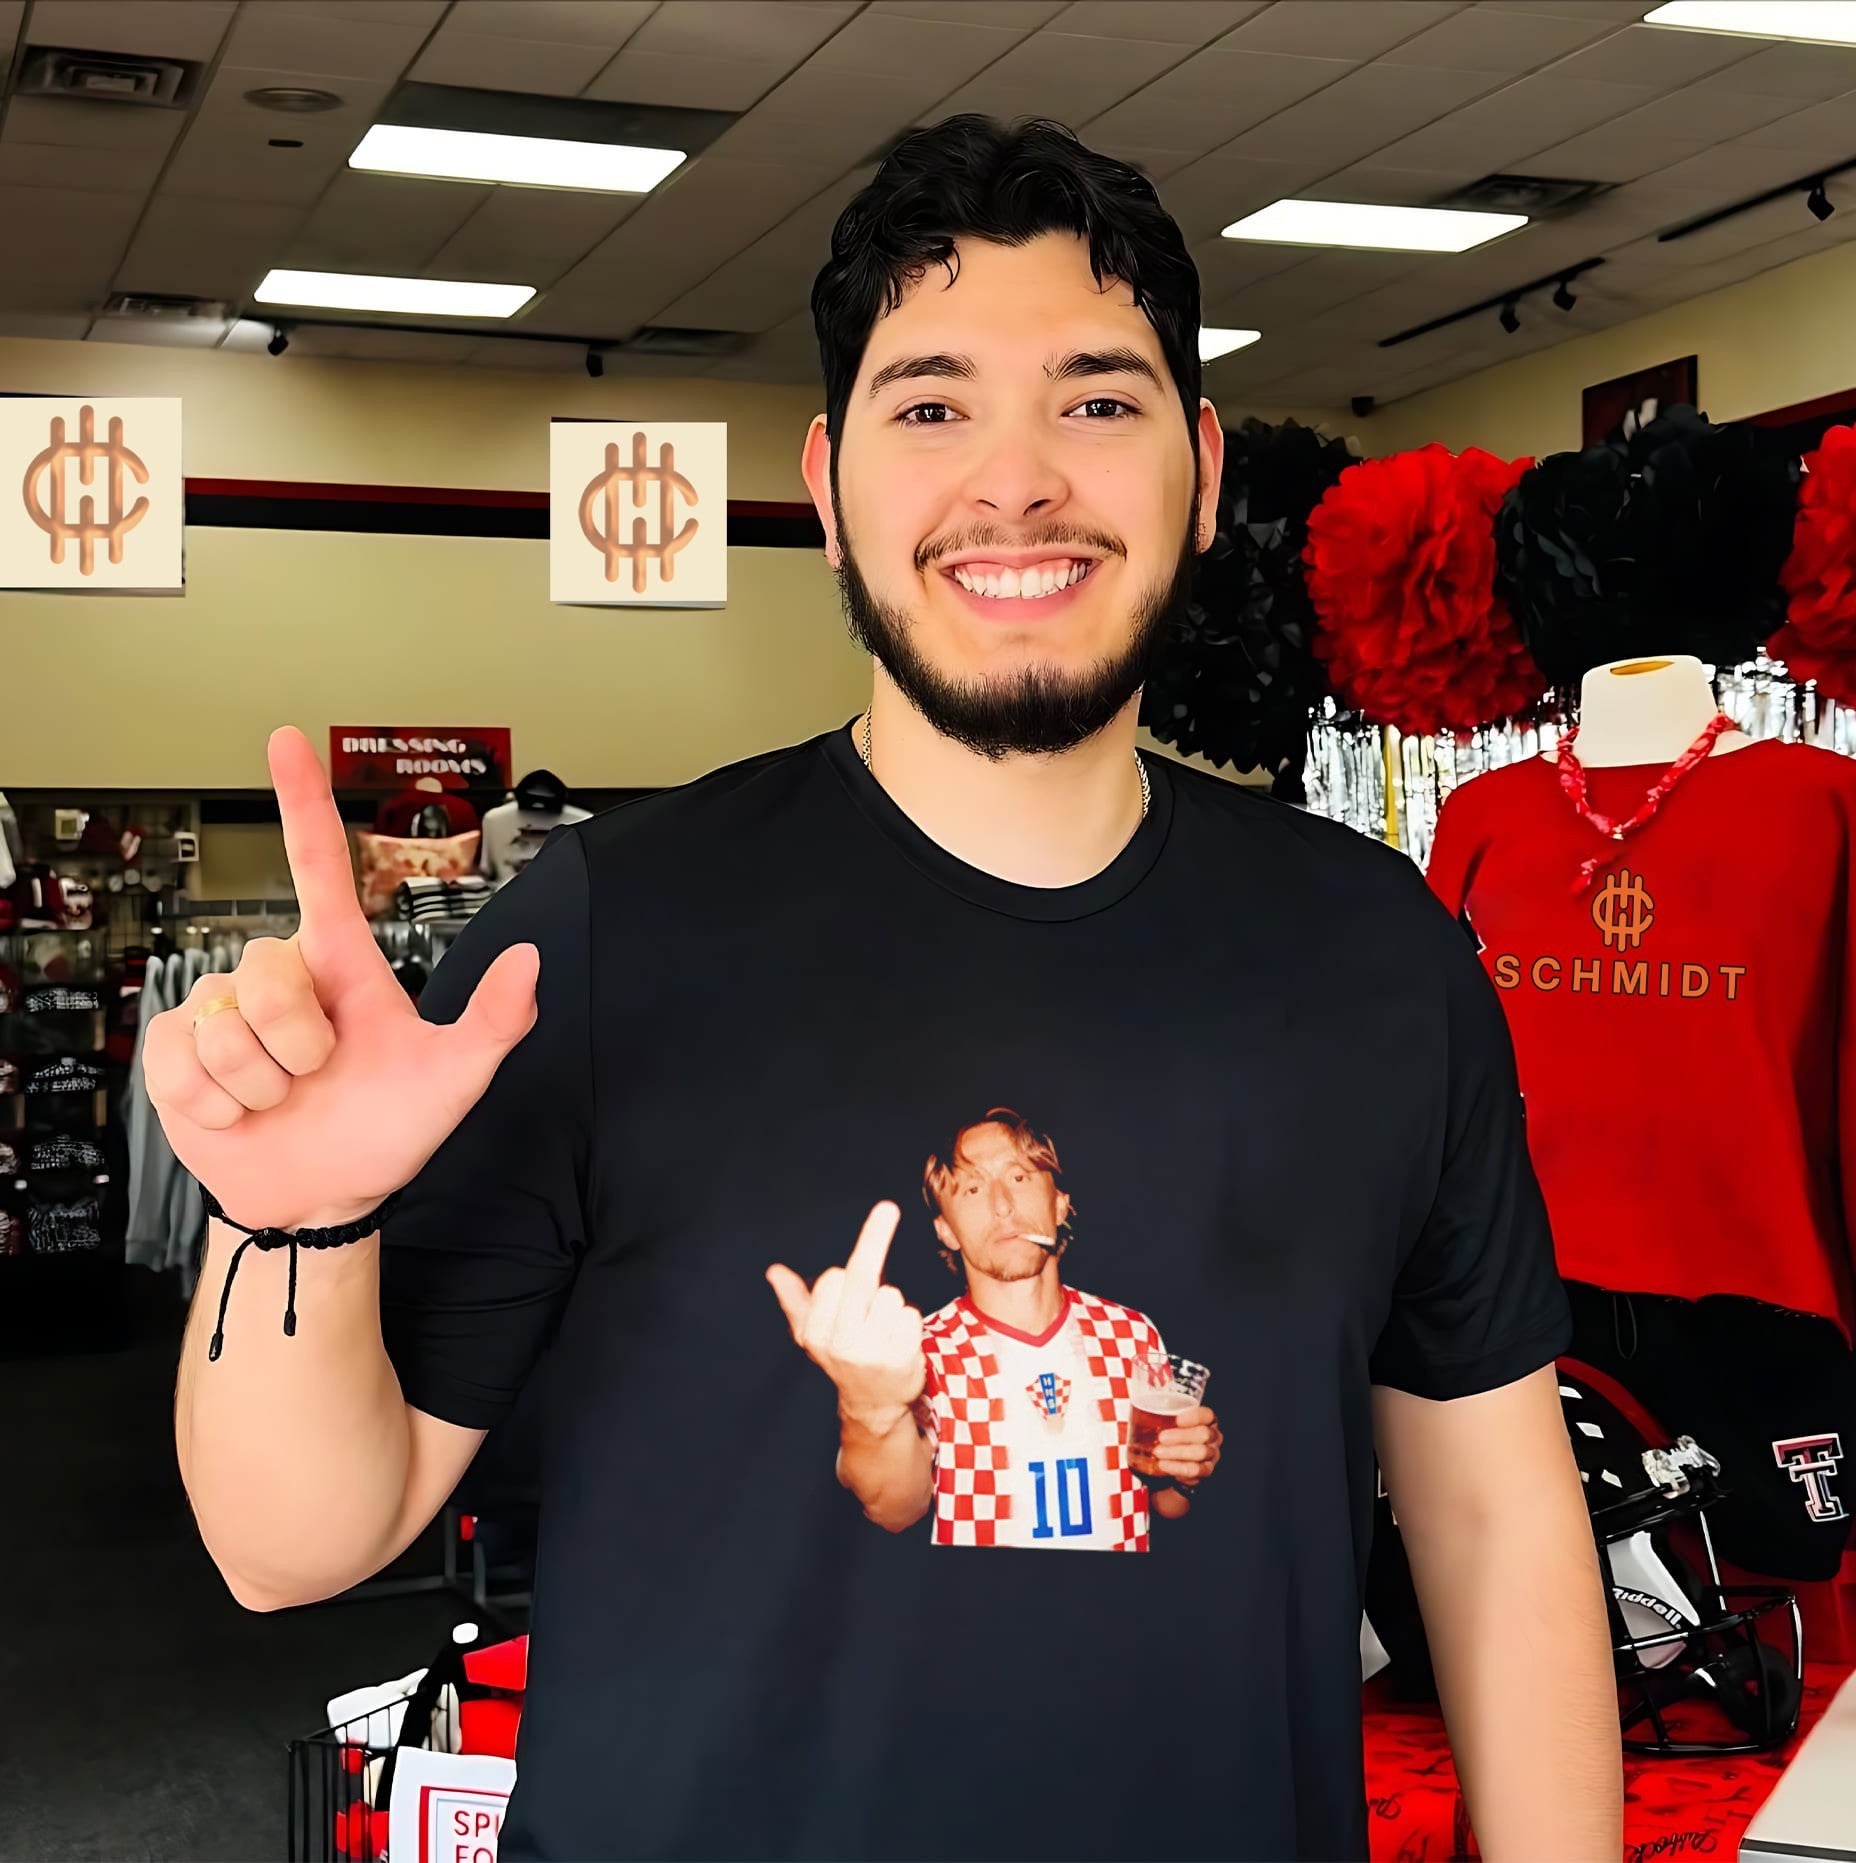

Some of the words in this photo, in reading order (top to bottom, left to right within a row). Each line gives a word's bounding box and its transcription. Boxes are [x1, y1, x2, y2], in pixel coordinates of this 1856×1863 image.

[342, 737, 467, 754] DRESSING
[396, 758, 487, 775] ROOMS
[1494, 953, 1747, 1000] SCHMIDT
[1028, 1457, 1093, 1538] 10
